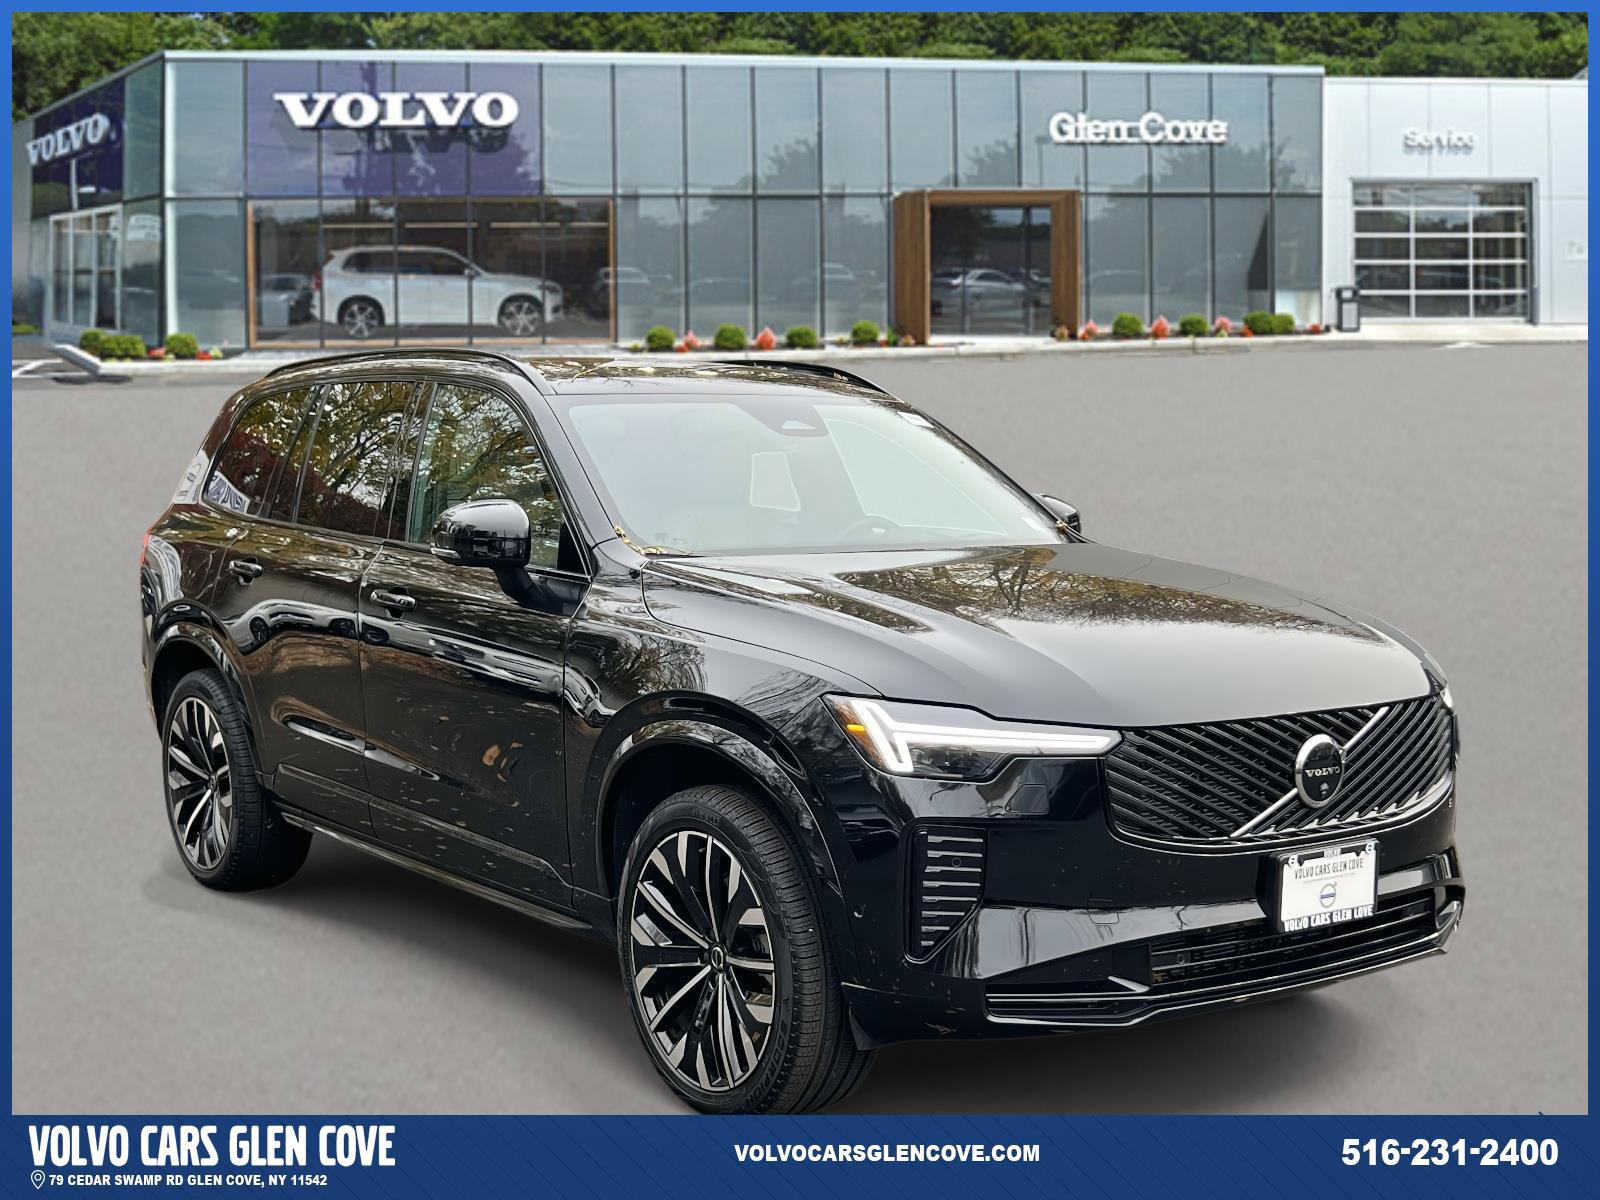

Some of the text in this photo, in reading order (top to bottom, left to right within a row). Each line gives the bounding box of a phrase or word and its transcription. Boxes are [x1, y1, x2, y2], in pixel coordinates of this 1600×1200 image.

[272, 92, 519, 127] VOLVO
[26, 113, 110, 165] VOLVO
[1049, 111, 1228, 143] Glen Cove
[1403, 127, 1476, 150] Service
[1305, 765, 1341, 777] VOLVO
[1295, 857, 1364, 879] VOLVO CARS GLEN COVE
[1284, 916, 1309, 932] VOLVO
[1310, 911, 1331, 927] CARS
[1333, 907, 1353, 922] GLEN
